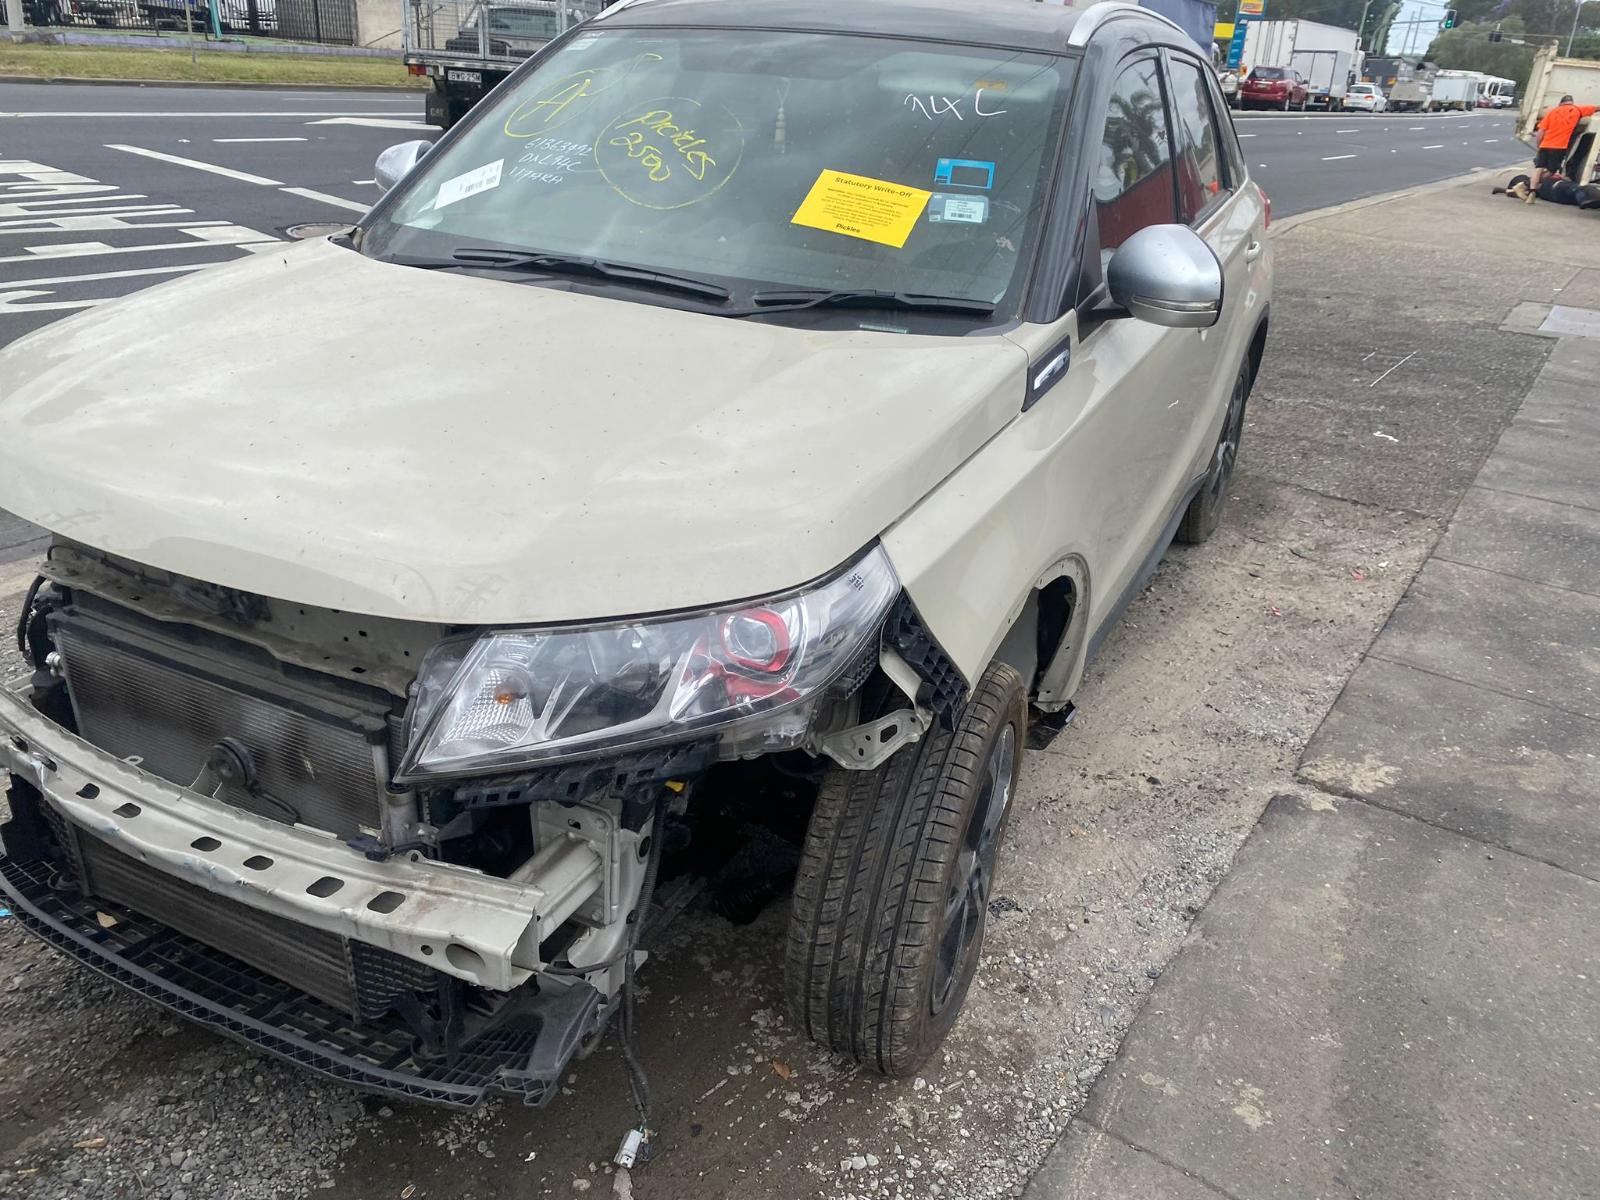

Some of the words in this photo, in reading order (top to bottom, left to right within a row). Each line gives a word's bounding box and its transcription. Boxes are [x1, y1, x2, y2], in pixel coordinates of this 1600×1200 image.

[834, 177, 872, 190] Statutory
[874, 185, 913, 198] Write-Off
[836, 223, 861, 233] Pickles
